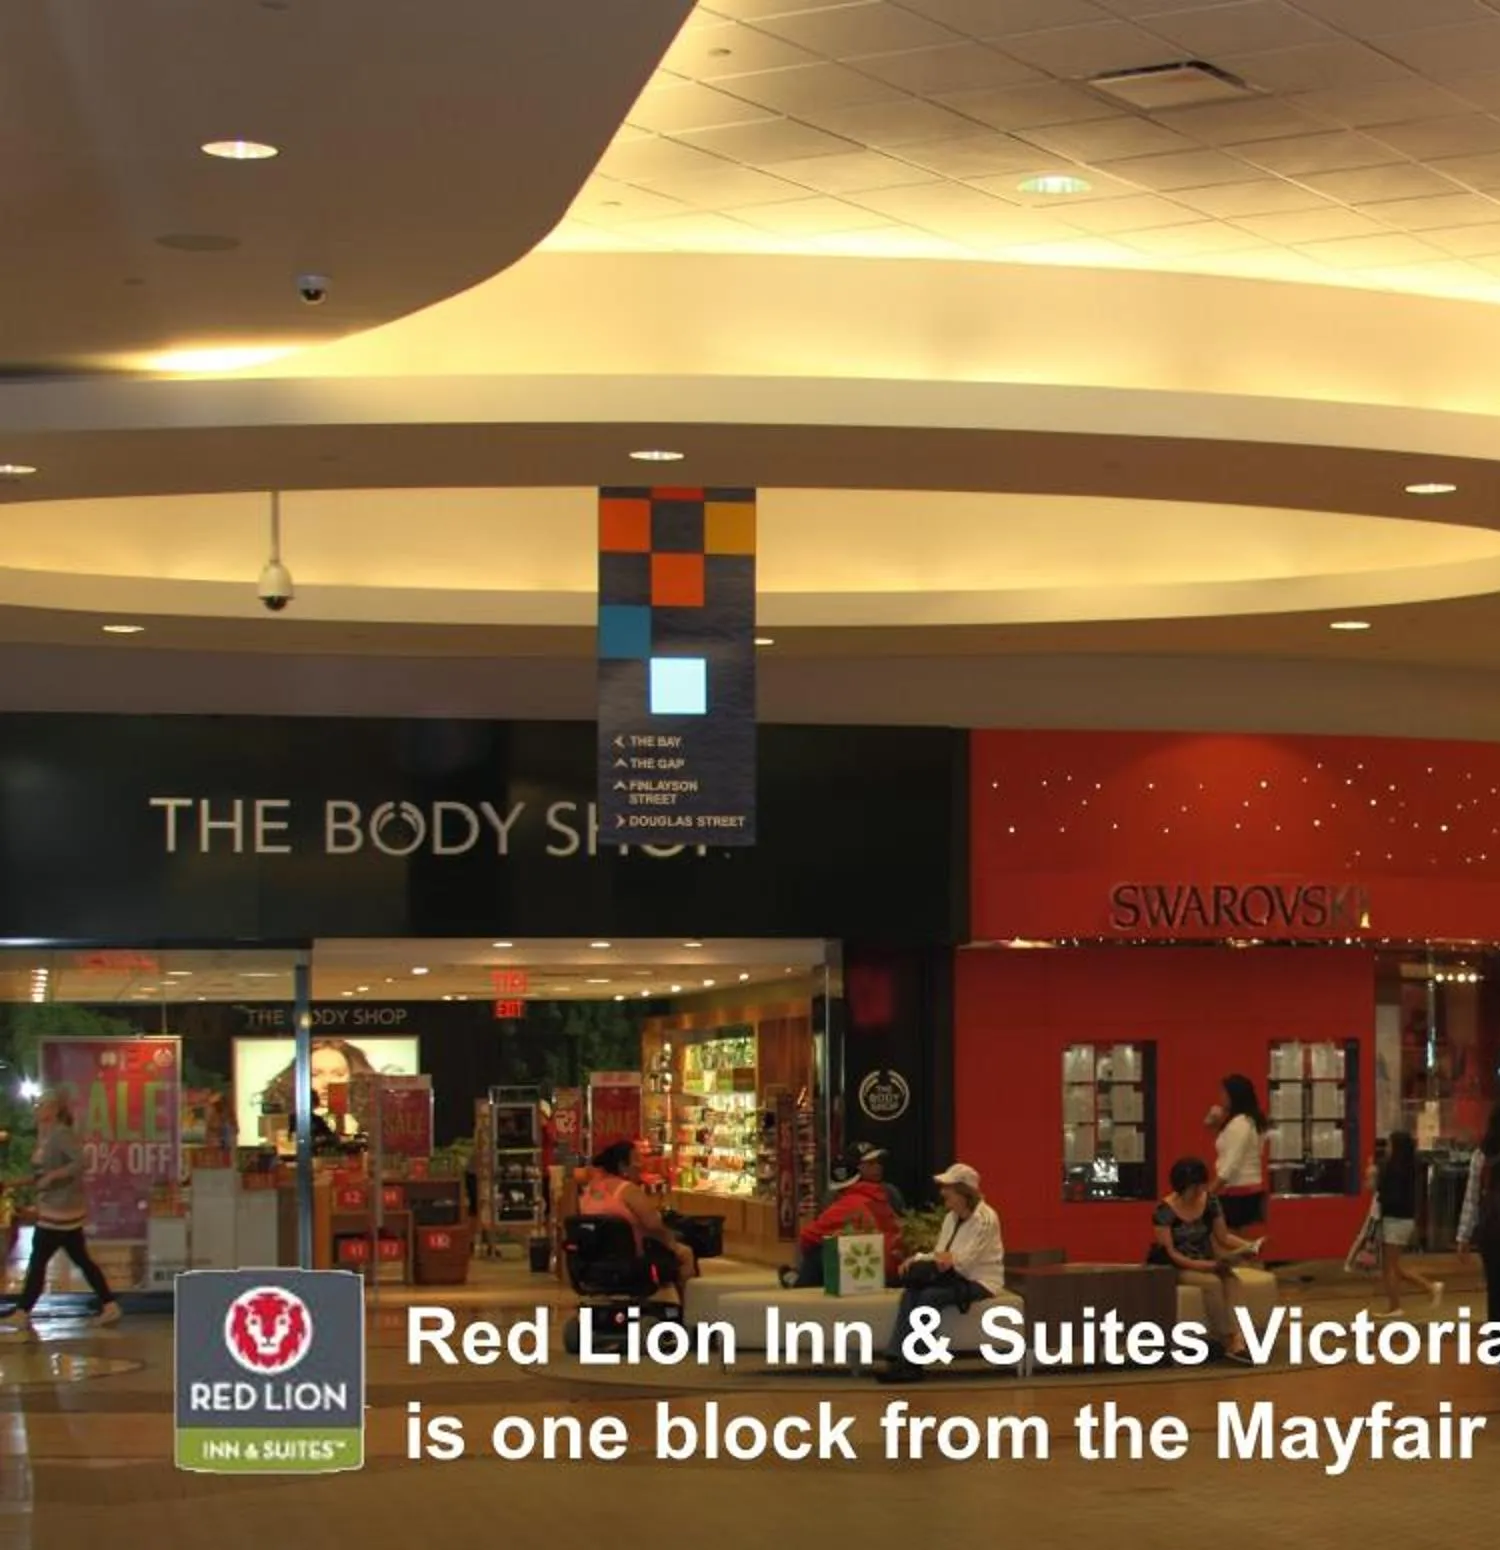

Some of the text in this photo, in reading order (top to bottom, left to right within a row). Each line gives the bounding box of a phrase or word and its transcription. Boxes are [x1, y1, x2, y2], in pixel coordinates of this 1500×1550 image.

[630, 735, 682, 748] THE BAY
[630, 758, 685, 769] THE GAP
[629, 780, 698, 792] FINLAYSON
[628, 794, 677, 805] STREET
[150, 797, 292, 854] THE
[325, 799, 526, 857] BODY
[629, 816, 746, 827] DOUGLAS STREET
[1111, 884, 1371, 930] SWAROVSKI
[249, 1009, 285, 1025] THE
[353, 1008, 408, 1025] SHOP
[128, 1143, 172, 1175] OFF
